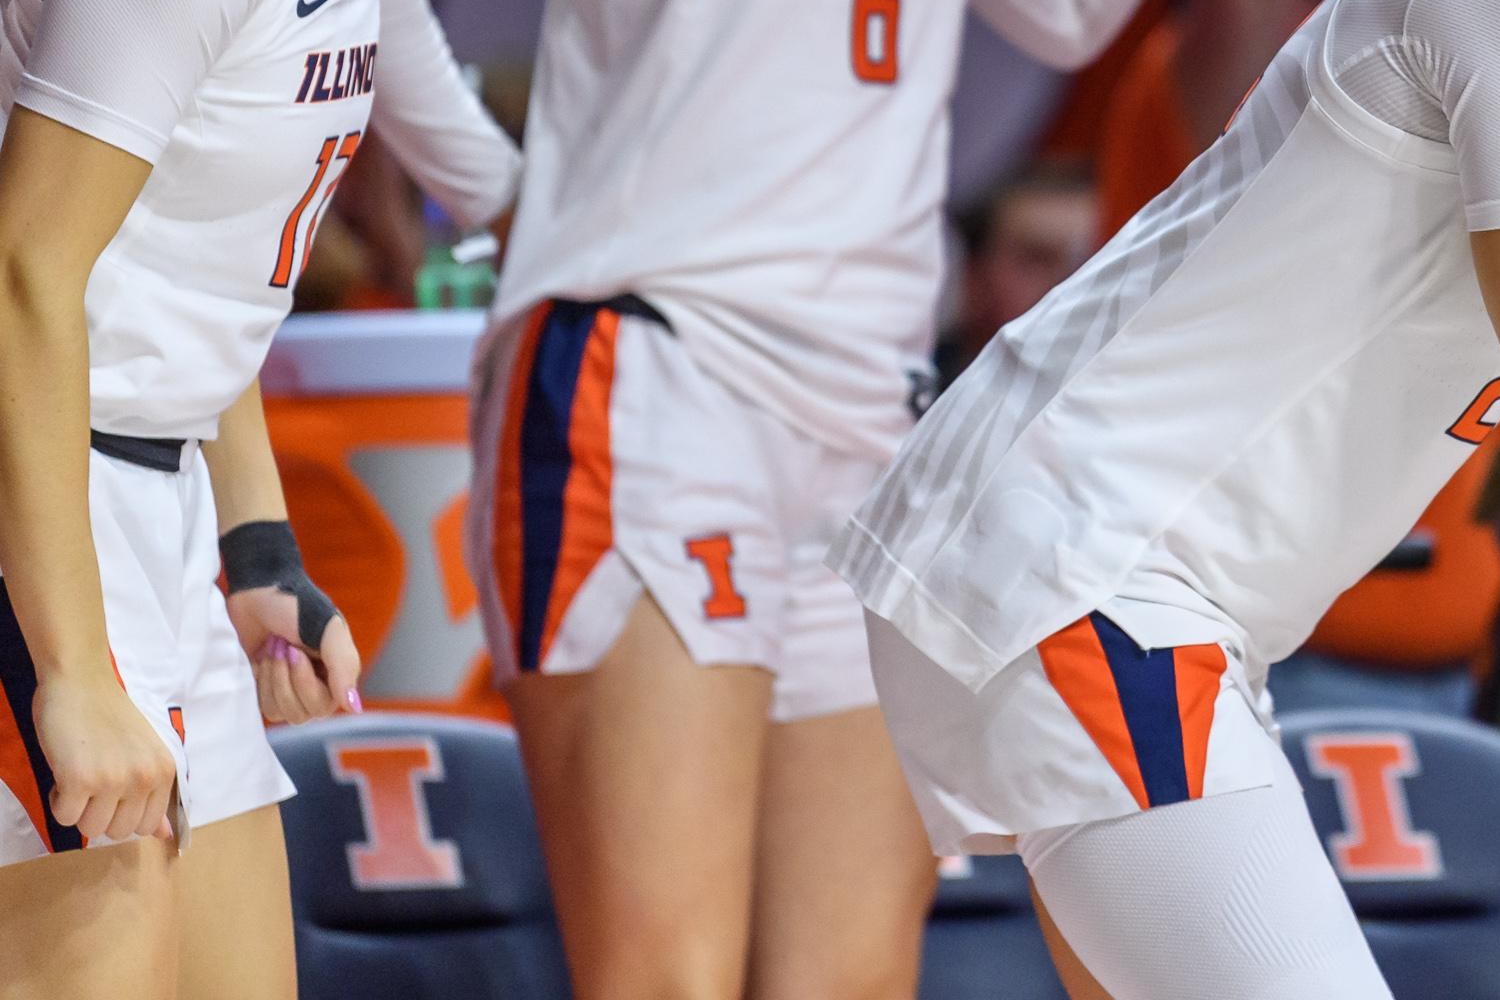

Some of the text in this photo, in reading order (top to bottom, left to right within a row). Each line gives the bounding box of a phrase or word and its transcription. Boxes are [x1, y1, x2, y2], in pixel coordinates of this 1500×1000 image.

[686, 533, 747, 621] I
[326, 735, 466, 892] I
[1303, 731, 1443, 882] I
